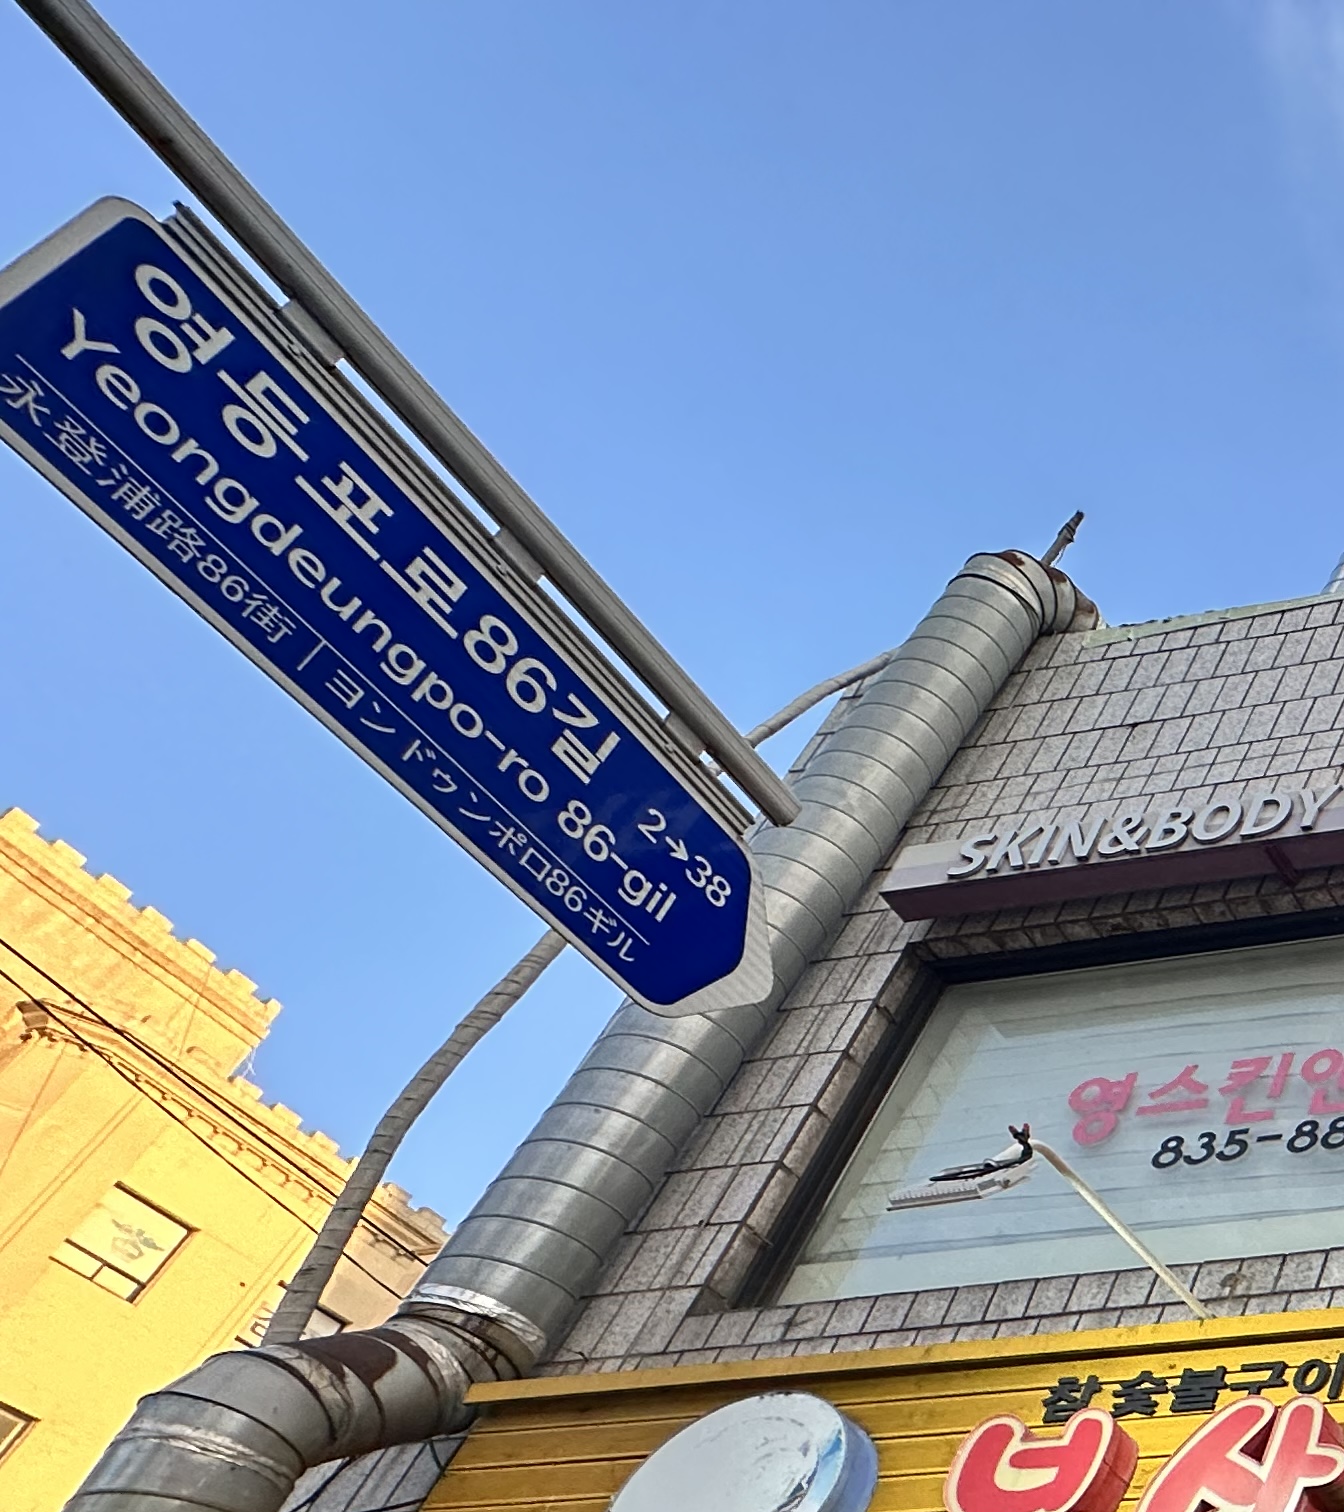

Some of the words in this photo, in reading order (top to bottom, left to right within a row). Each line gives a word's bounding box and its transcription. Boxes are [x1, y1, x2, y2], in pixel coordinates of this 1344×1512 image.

[0, 372, 297, 643] 永登浦路86街
[60, 309, 551, 802] Yeongdeungpo-ro
[557, 800, 677, 922] 86-gil
[134, 264, 621, 785] 영등포로86길
